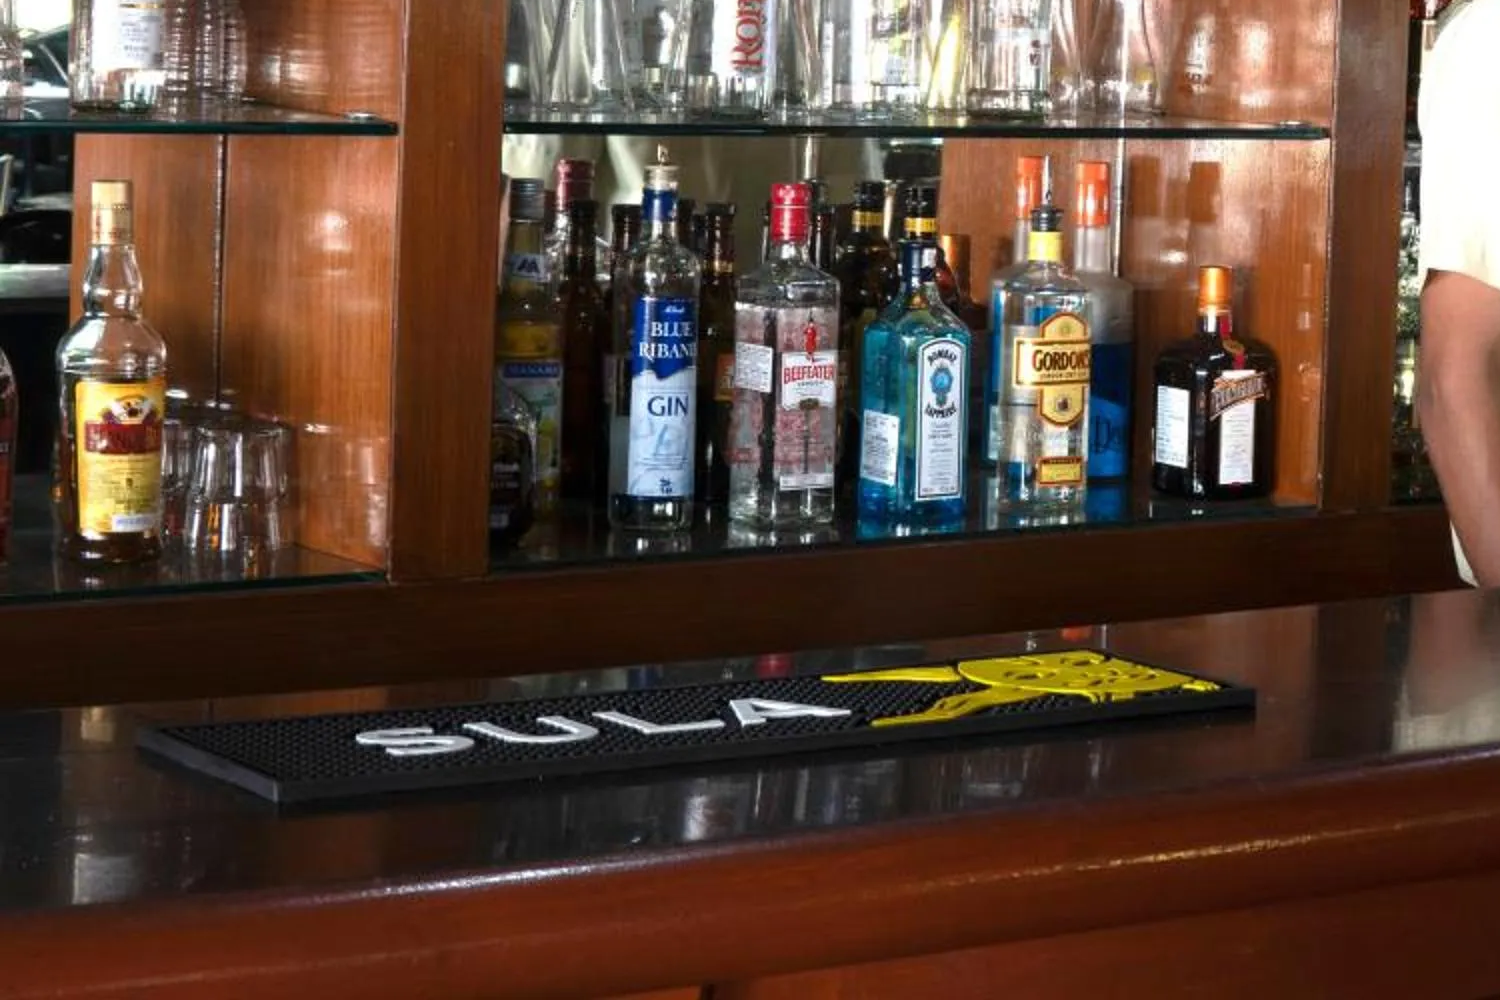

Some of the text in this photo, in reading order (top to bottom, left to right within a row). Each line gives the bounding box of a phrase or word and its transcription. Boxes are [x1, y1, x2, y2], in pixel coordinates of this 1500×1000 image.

[651, 321, 694, 337] BLUE
[783, 364, 835, 384] BEEFEATER
[647, 395, 689, 417] GIN
[355, 697, 851, 757] SULA
